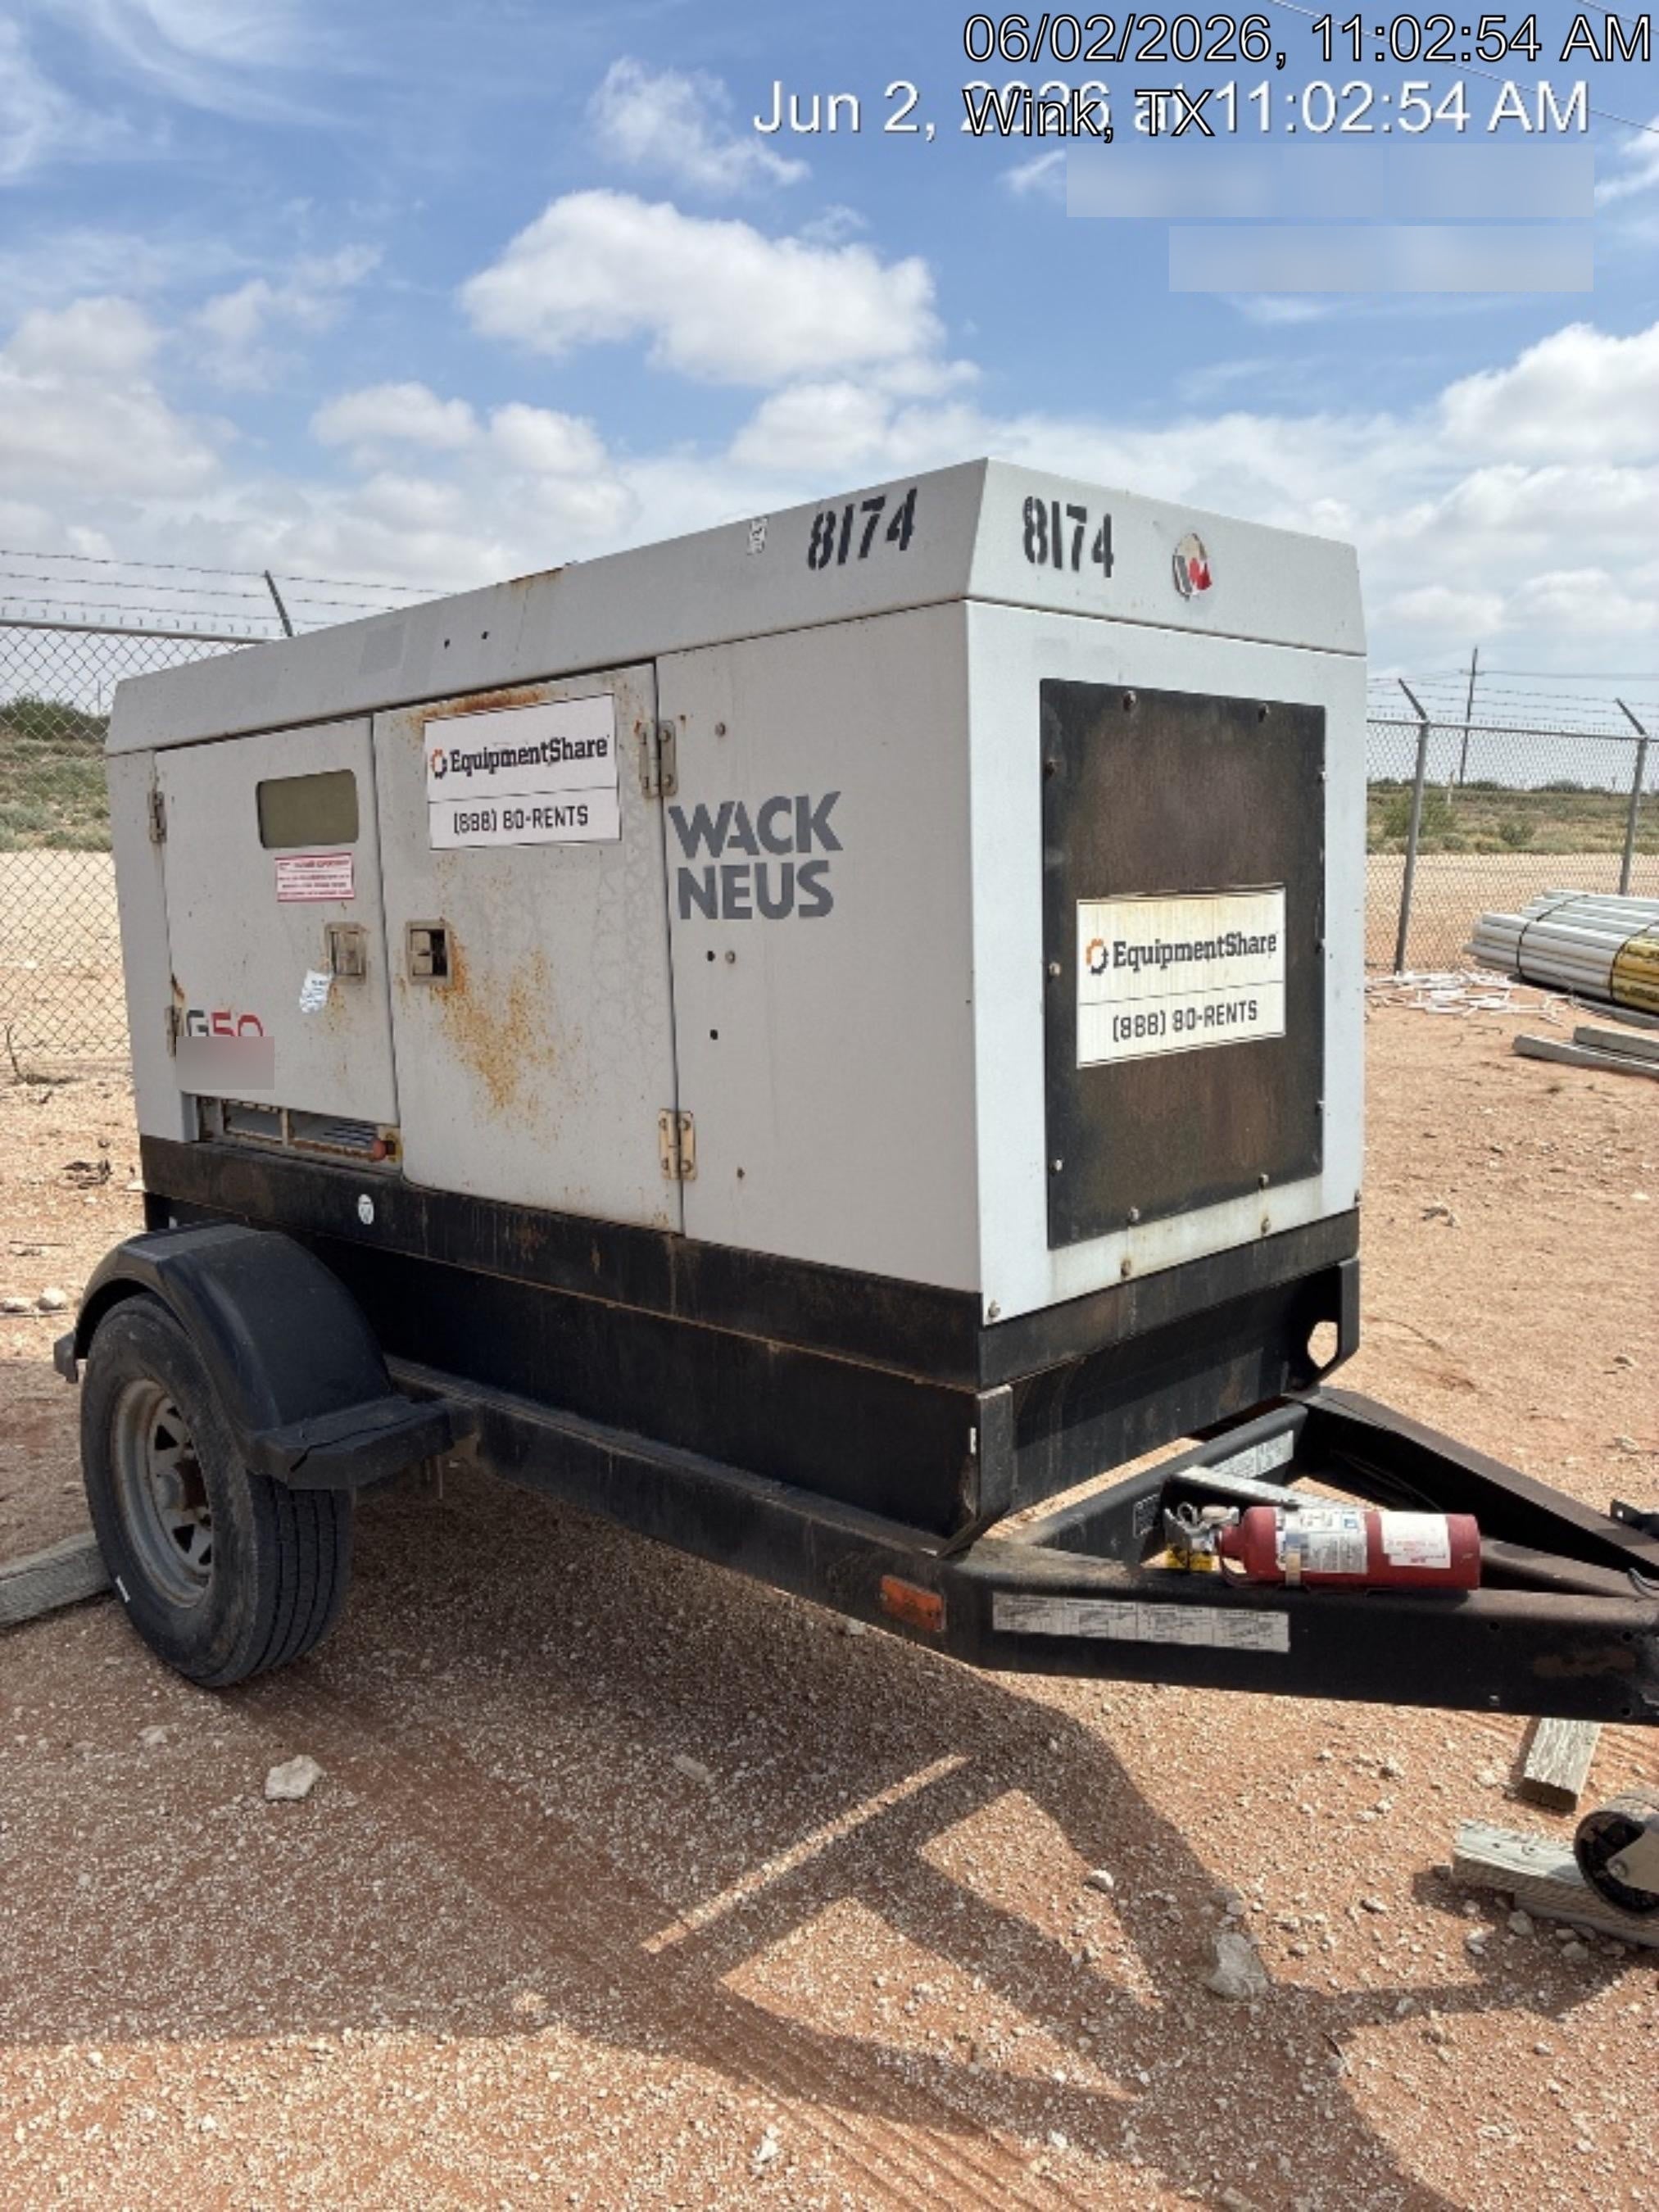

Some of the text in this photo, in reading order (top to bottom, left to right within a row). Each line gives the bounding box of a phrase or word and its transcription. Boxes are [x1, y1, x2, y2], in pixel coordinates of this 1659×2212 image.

[808, 487, 918, 571] 8174
[1022, 496, 1114, 578] 8174
[450, 737, 609, 777] EquipmentShare
[668, 791, 845, 859] WACK
[678, 859, 834, 920] NEUS
[1113, 931, 1277, 973] EquipmentShare
